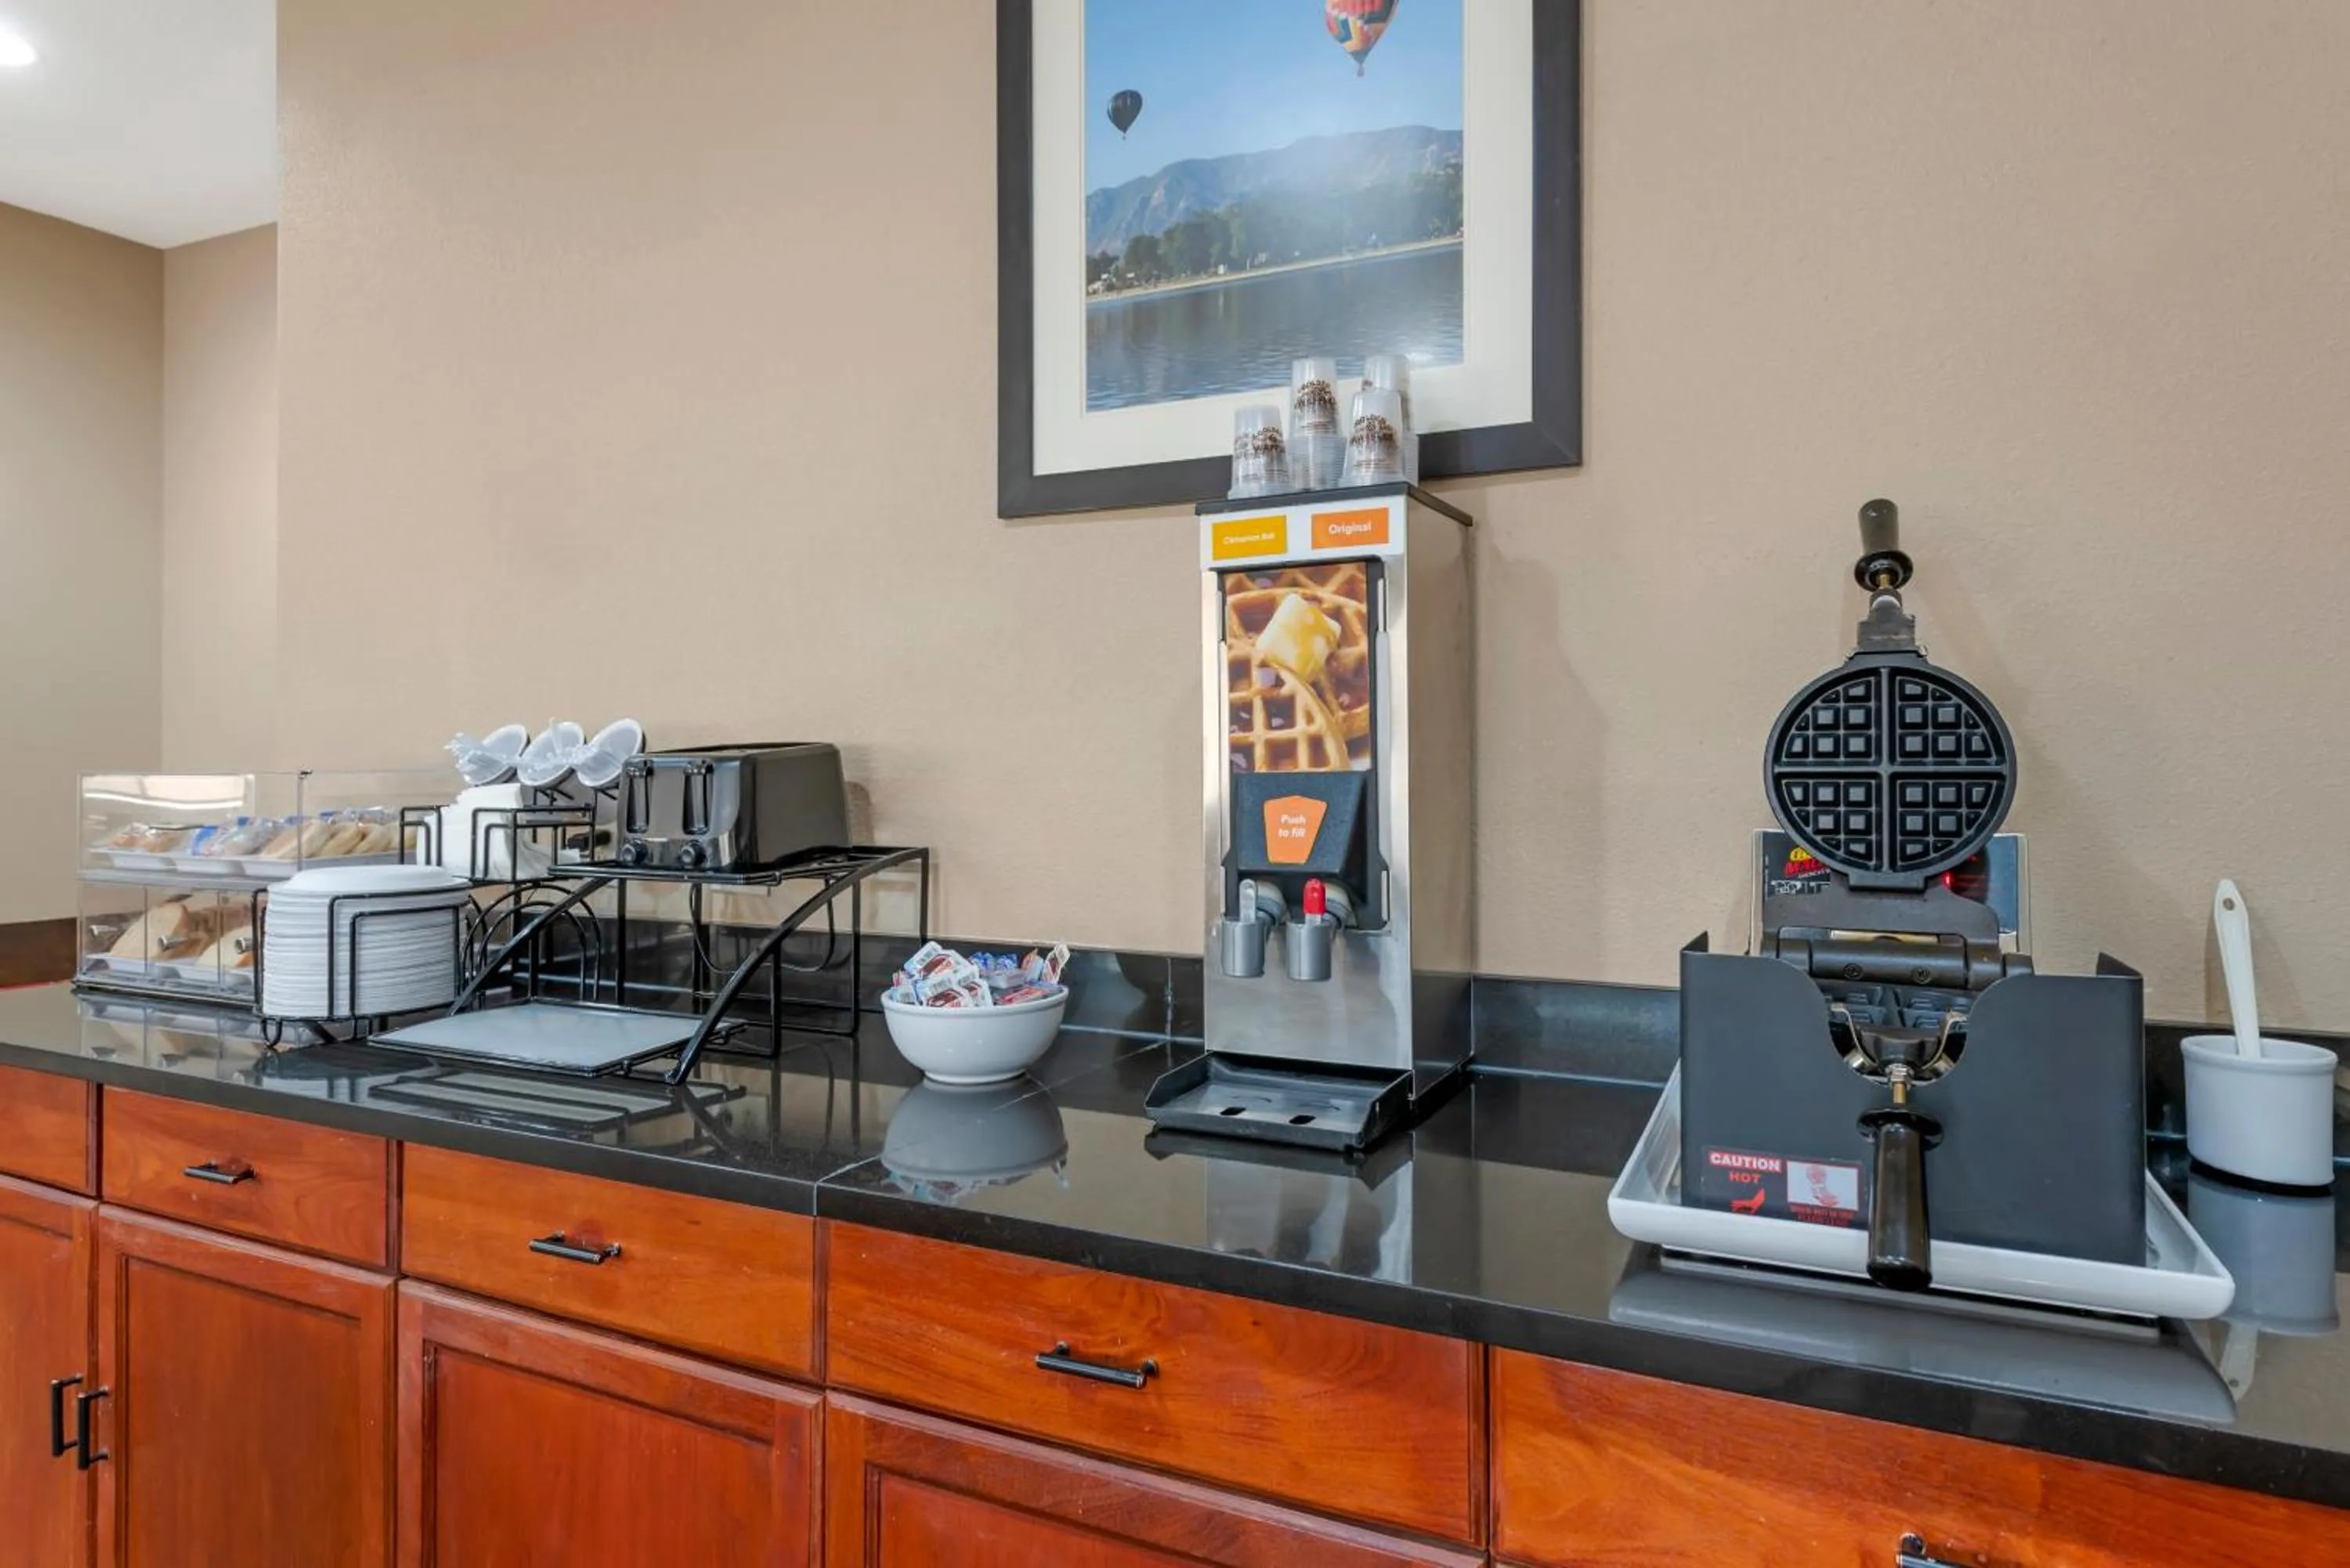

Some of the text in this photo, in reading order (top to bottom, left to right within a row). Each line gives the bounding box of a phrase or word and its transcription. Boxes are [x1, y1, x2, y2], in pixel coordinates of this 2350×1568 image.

[1328, 520, 1372, 535] Original
[1280, 814, 1306, 825] Push
[1278, 826, 1306, 837] to fill
[1710, 1151, 1781, 1172] CAUTION
[1729, 1172, 1760, 1184] HOT
